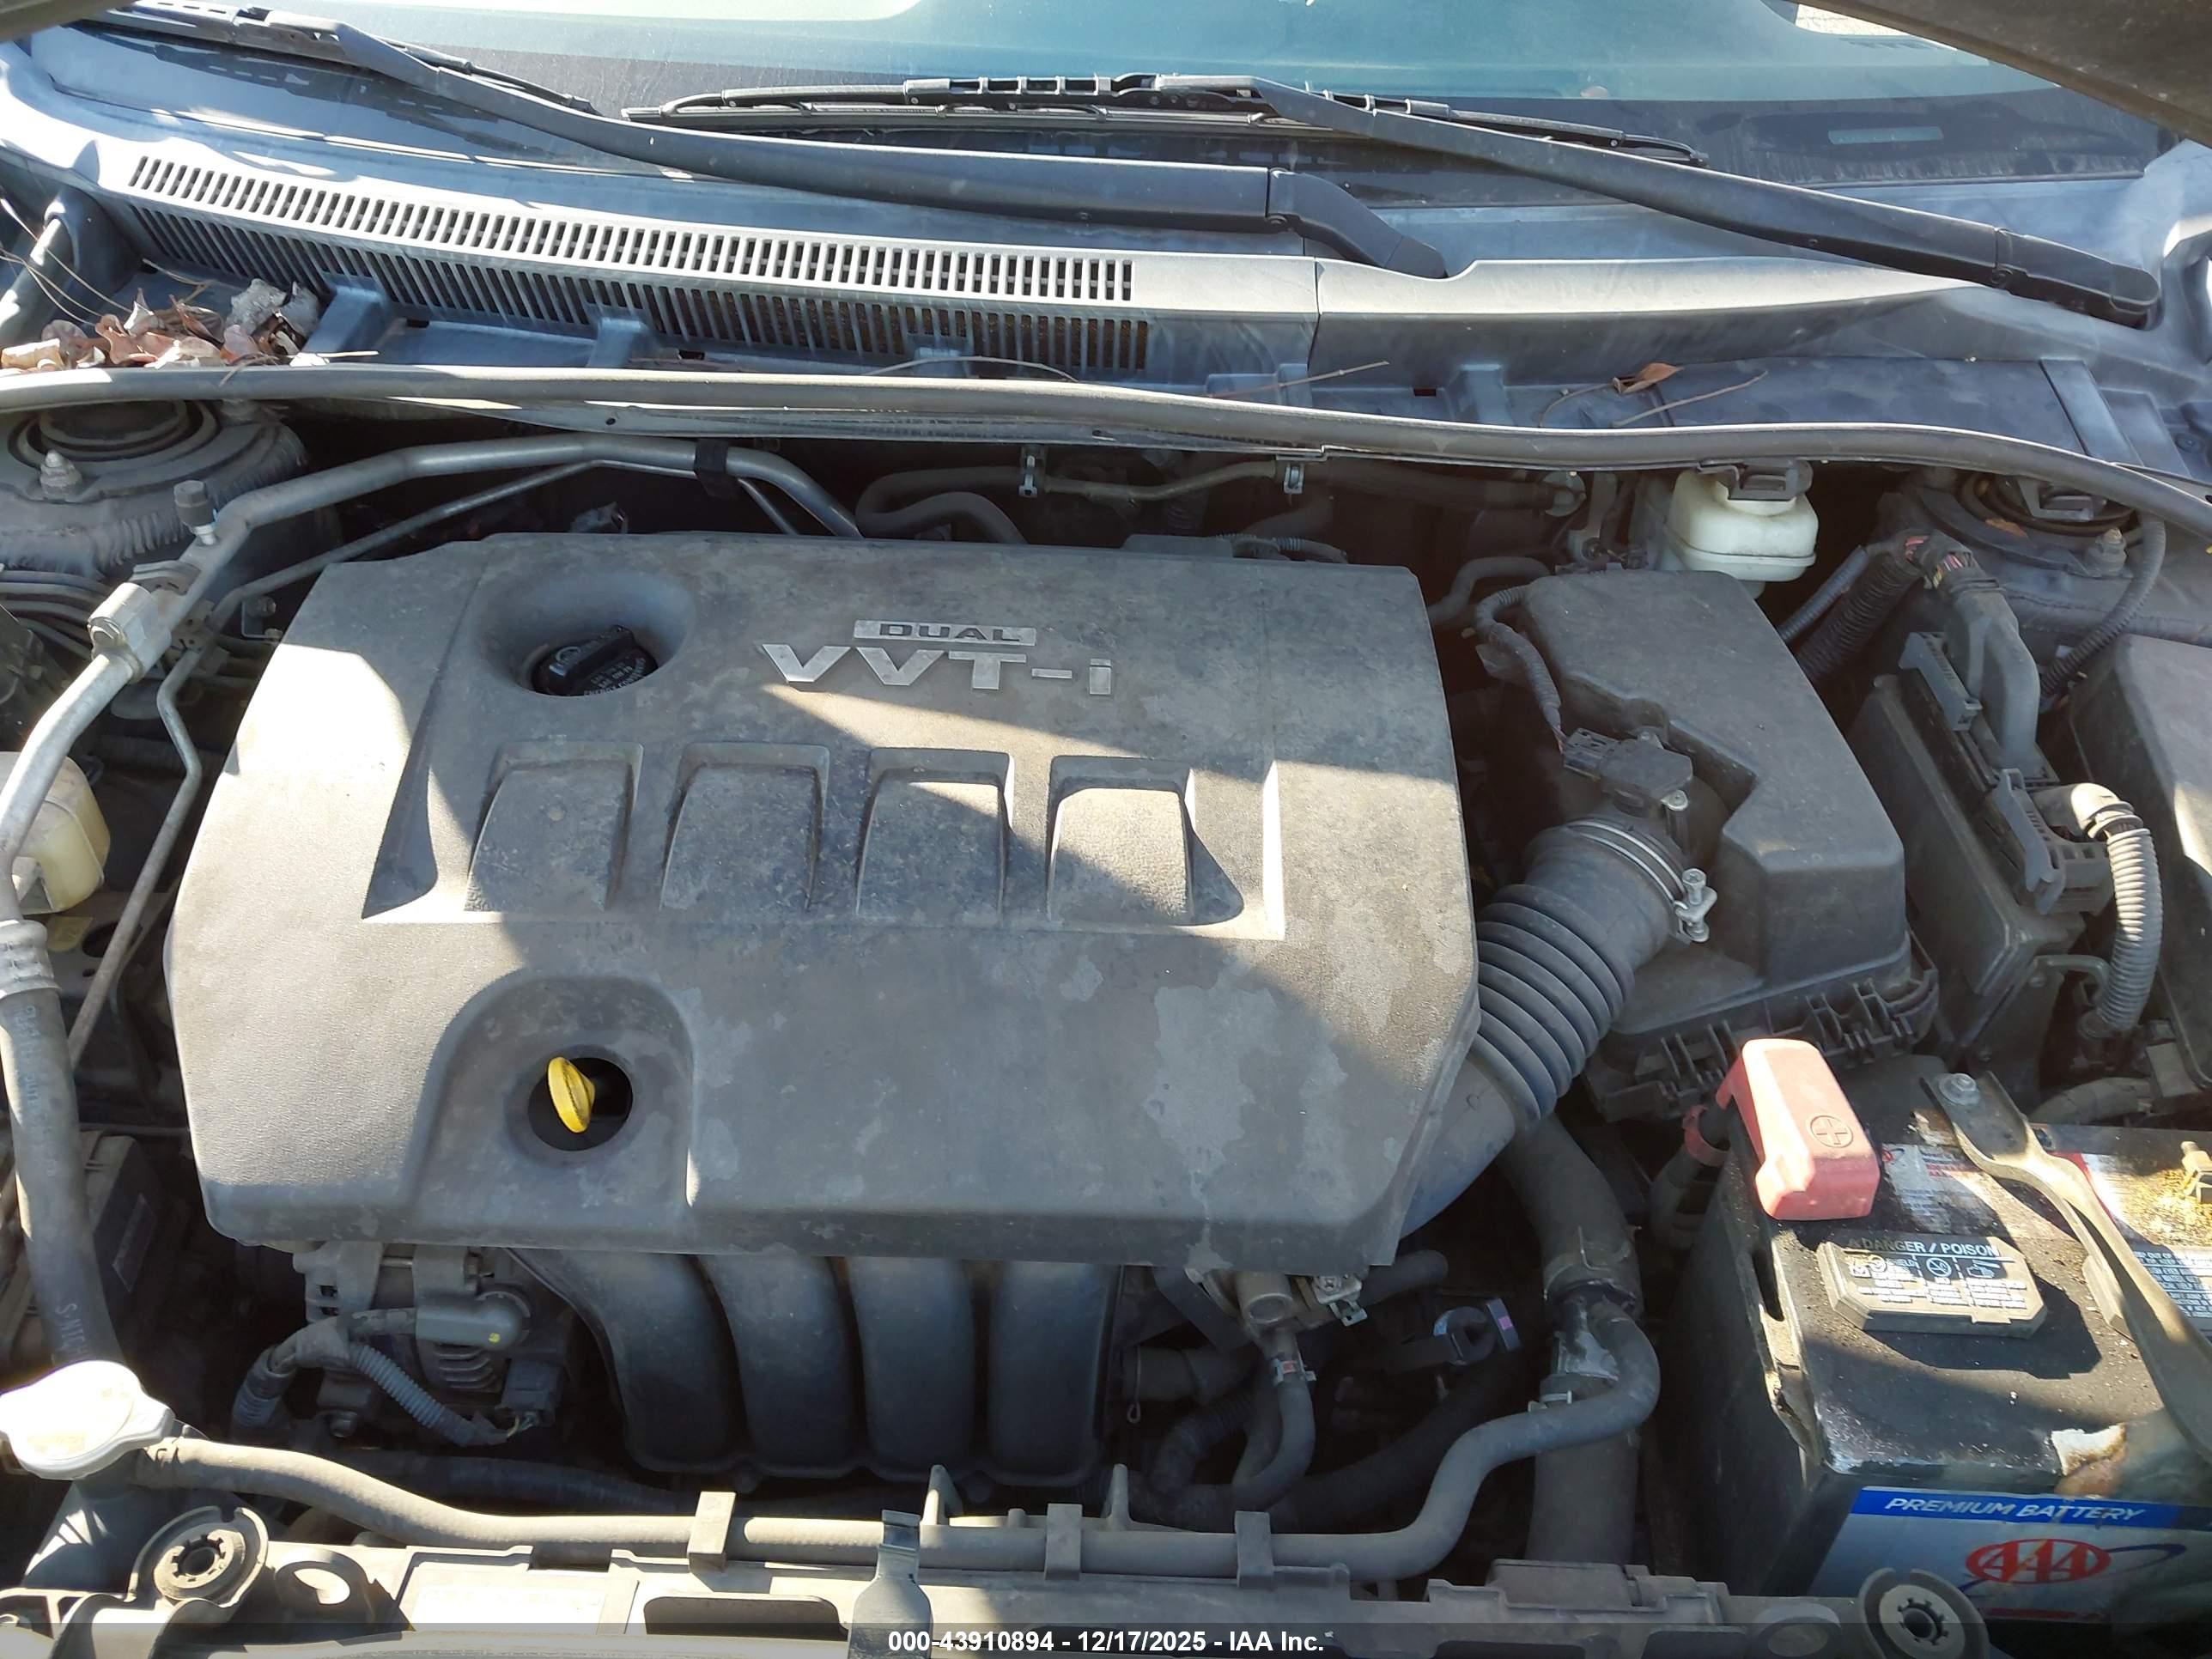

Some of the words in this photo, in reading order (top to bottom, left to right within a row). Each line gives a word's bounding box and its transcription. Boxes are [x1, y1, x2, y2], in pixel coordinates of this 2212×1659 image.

[879, 623, 1020, 642] DUAL
[762, 643, 1112, 696] VVT-i
[1861, 1237, 1926, 1253] DANGER
[1929, 1242, 1937, 1254] /
[1940, 1243, 2000, 1257] POISON
[1884, 1498, 2016, 1516] PREMIUM
[2015, 1504, 2145, 1521] BATTERY
[1977, 1539, 2094, 1582] AAA
